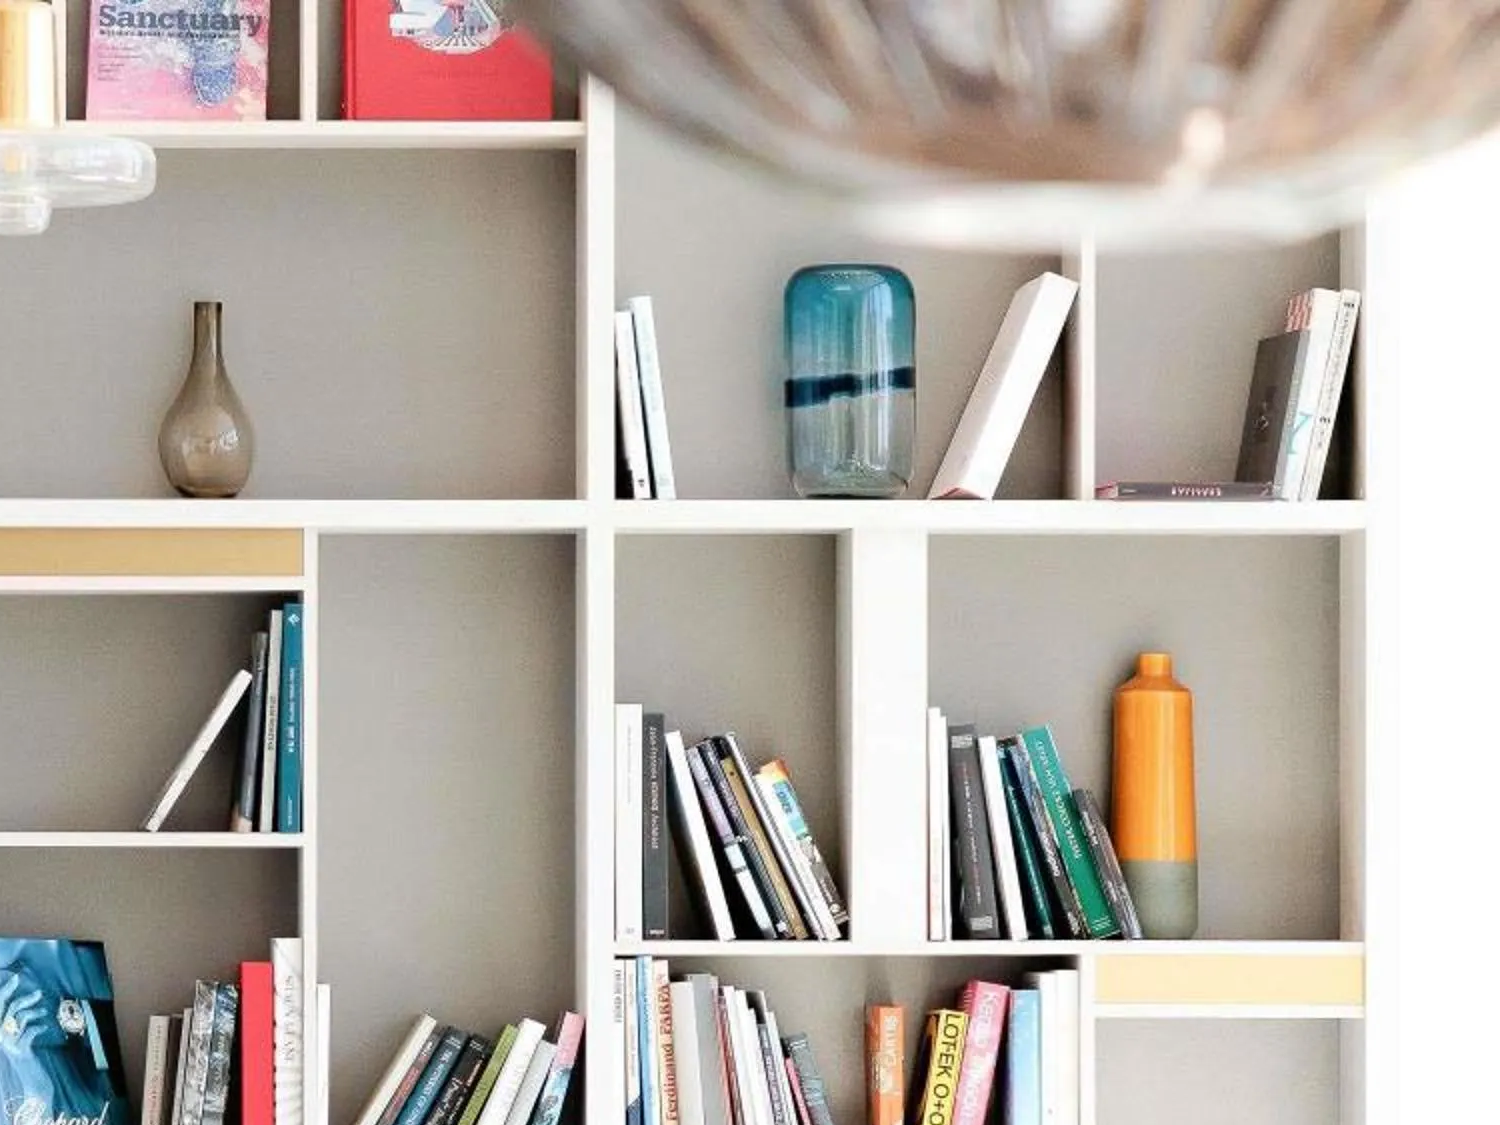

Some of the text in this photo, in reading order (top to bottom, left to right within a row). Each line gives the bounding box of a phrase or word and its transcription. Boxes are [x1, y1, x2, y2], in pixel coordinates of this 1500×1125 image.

[99, 4, 262, 37] Sanctuary
[935, 1013, 960, 1078] LOT-EK
[662, 1042, 678, 1121] Ferdinand
